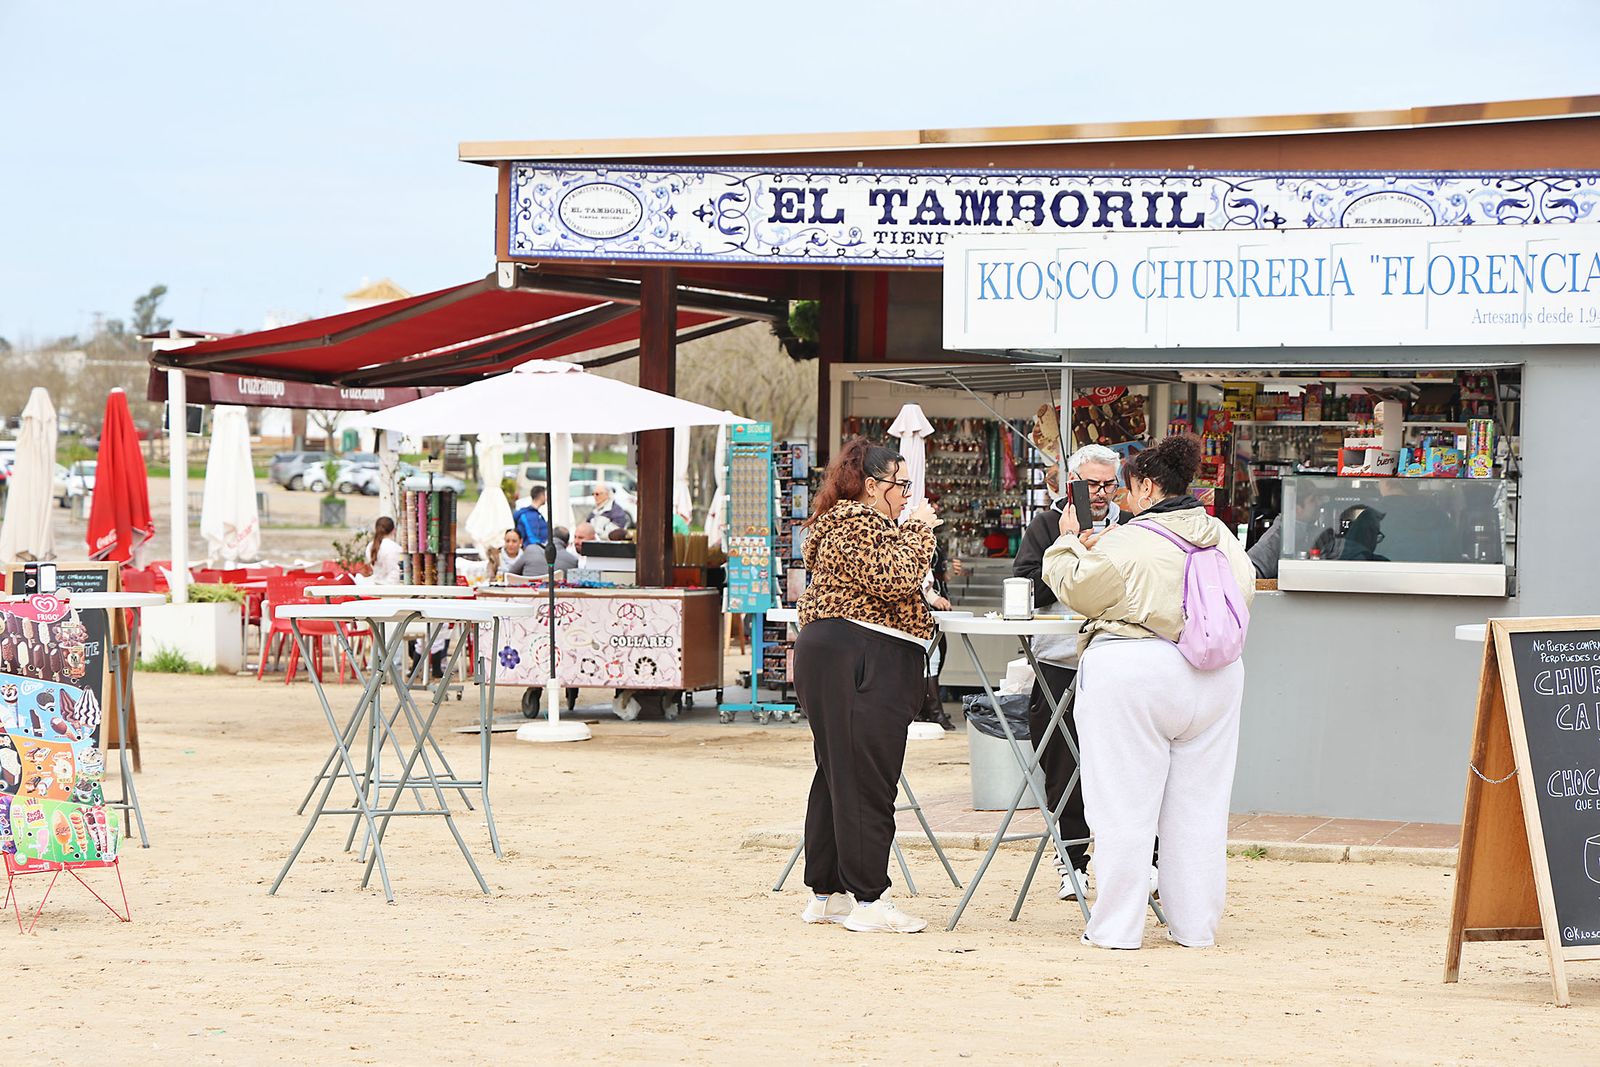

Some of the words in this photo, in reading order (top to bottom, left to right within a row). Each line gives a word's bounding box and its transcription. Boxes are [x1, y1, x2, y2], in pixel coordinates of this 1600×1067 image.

[584, 207, 632, 215] TAMBORIL
[767, 186, 845, 226] EL
[868, 187, 1206, 230] TAMBORIL
[1370, 217, 1423, 225] TAMBORIL
[976, 259, 1119, 302] KIOSCO
[1131, 256, 1355, 300] CHURRERIA
[1471, 308, 1533, 324] Artesanos
[1537, 306, 1574, 324] desde
[238, 376, 285, 399] Cruzcampo
[1376, 456, 1395, 467] bueno
[37, 613, 59, 621] FRIGO
[609, 634, 674, 648] COLLARES
[1546, 768, 1600, 798] CHOC
[1574, 798, 1593, 812] QUE
